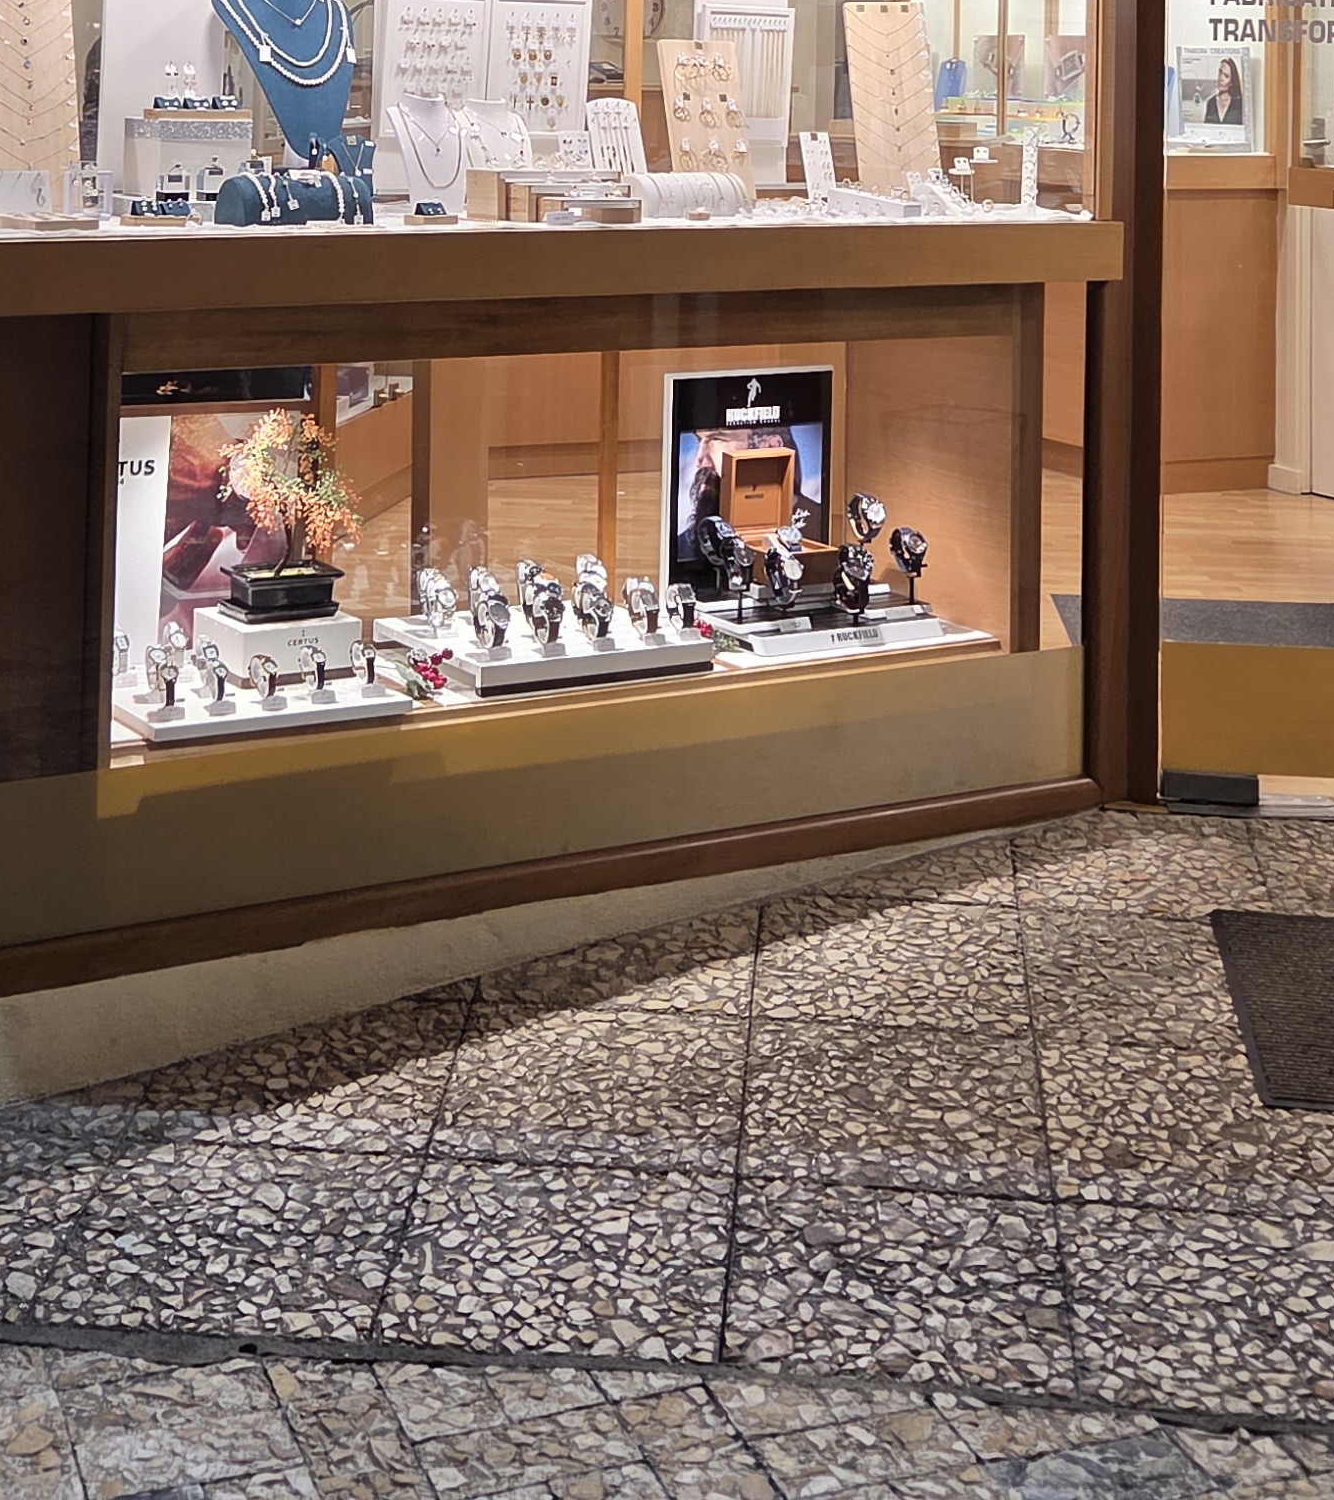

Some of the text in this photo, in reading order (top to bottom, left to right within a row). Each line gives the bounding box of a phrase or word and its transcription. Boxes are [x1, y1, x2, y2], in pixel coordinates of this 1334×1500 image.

[726, 406, 781, 421] RUCKFIELD
[287, 637, 319, 646] CERTUS
[836, 628, 878, 642] RUCKFIELD
